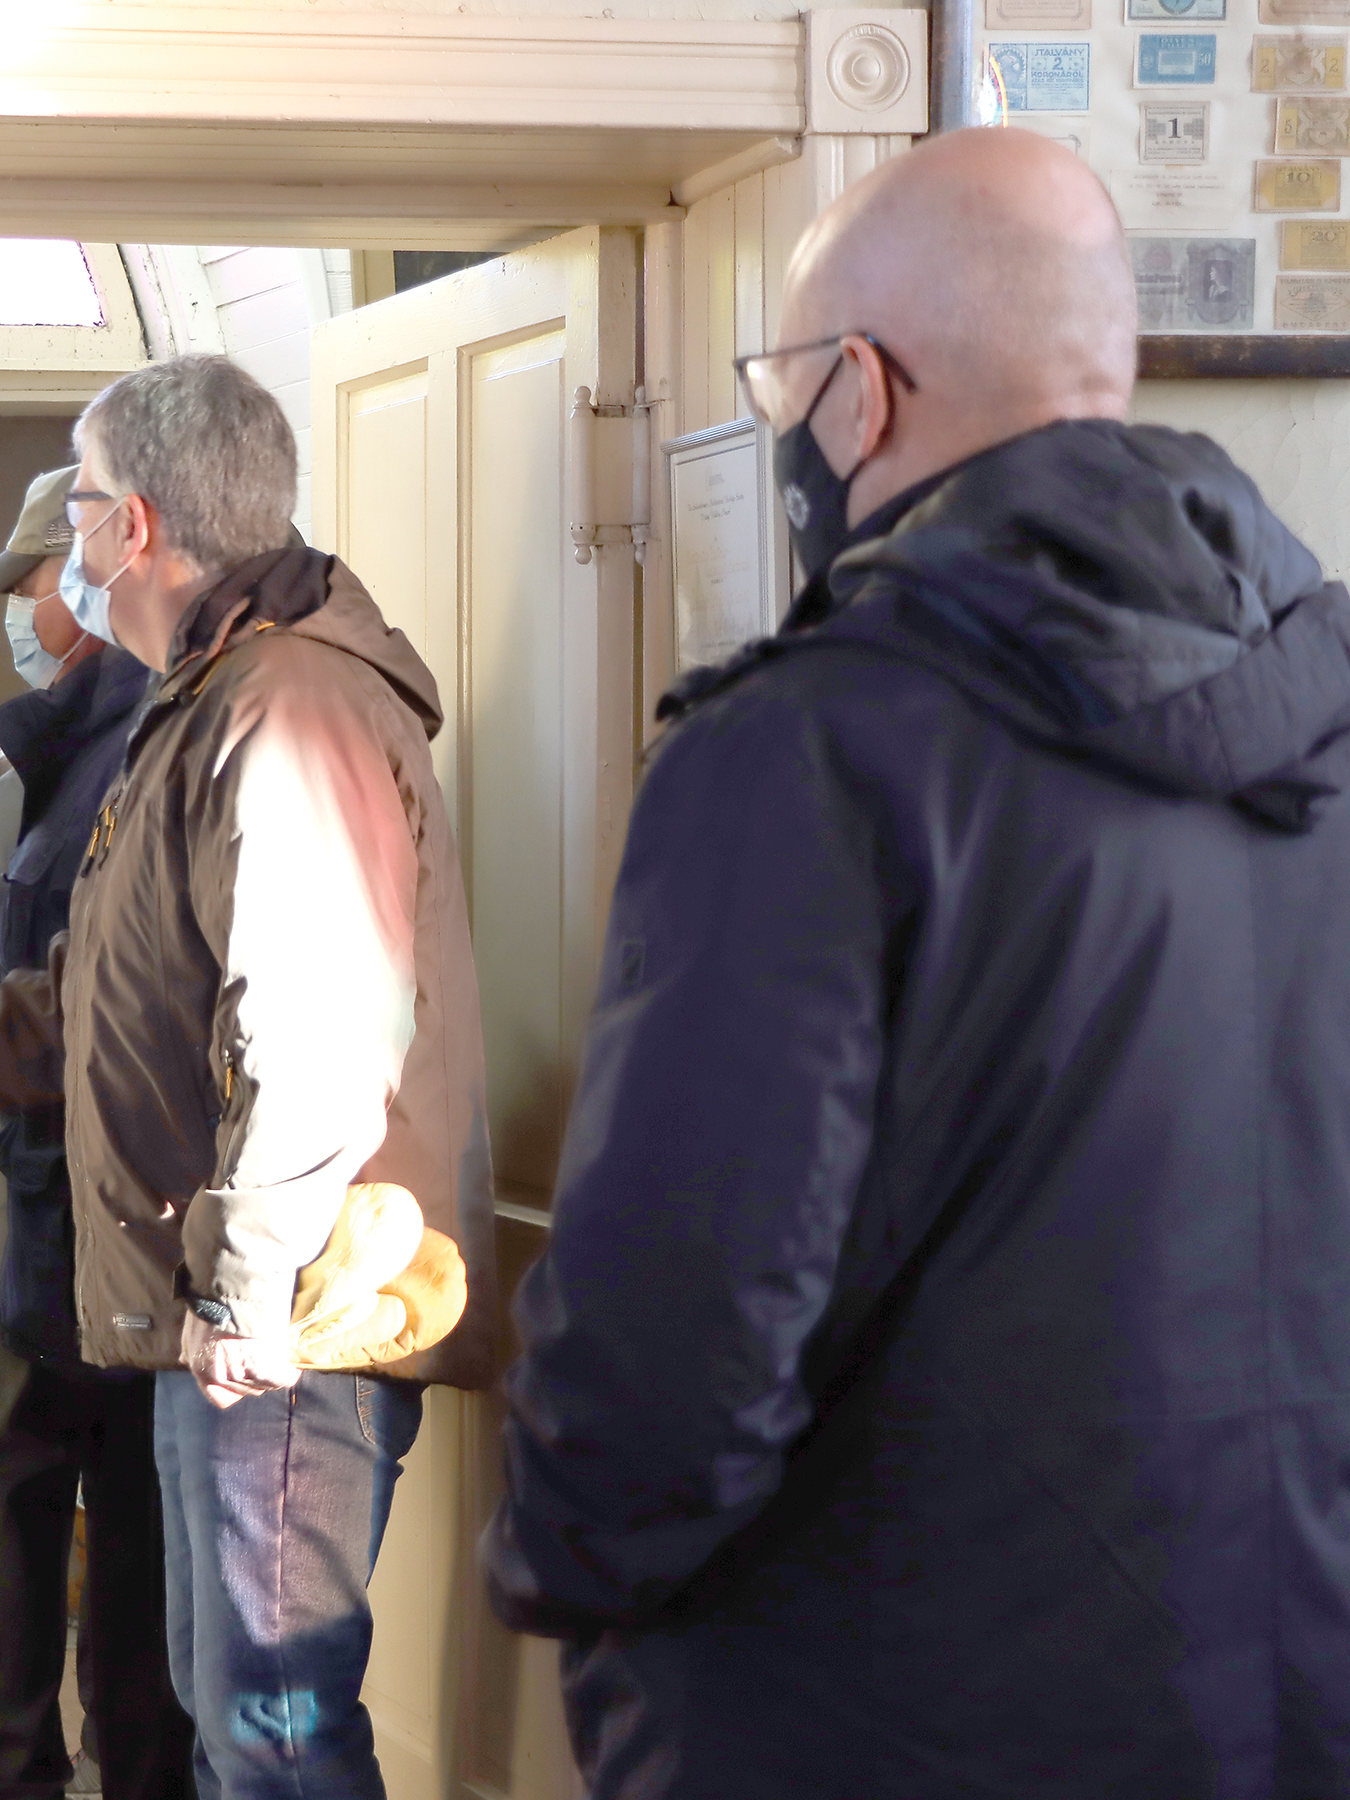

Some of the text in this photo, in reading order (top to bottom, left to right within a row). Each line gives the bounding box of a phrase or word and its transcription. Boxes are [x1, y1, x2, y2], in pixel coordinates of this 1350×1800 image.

[1052, 57, 1064, 71] 2
[1260, 59, 1270, 74] 2
[1329, 58, 1339, 73] 2
[1168, 117, 1182, 139] 1
[1283, 119, 1293, 135] 5
[1286, 171, 1311, 184] 10
[1311, 230, 1339, 243] 20
